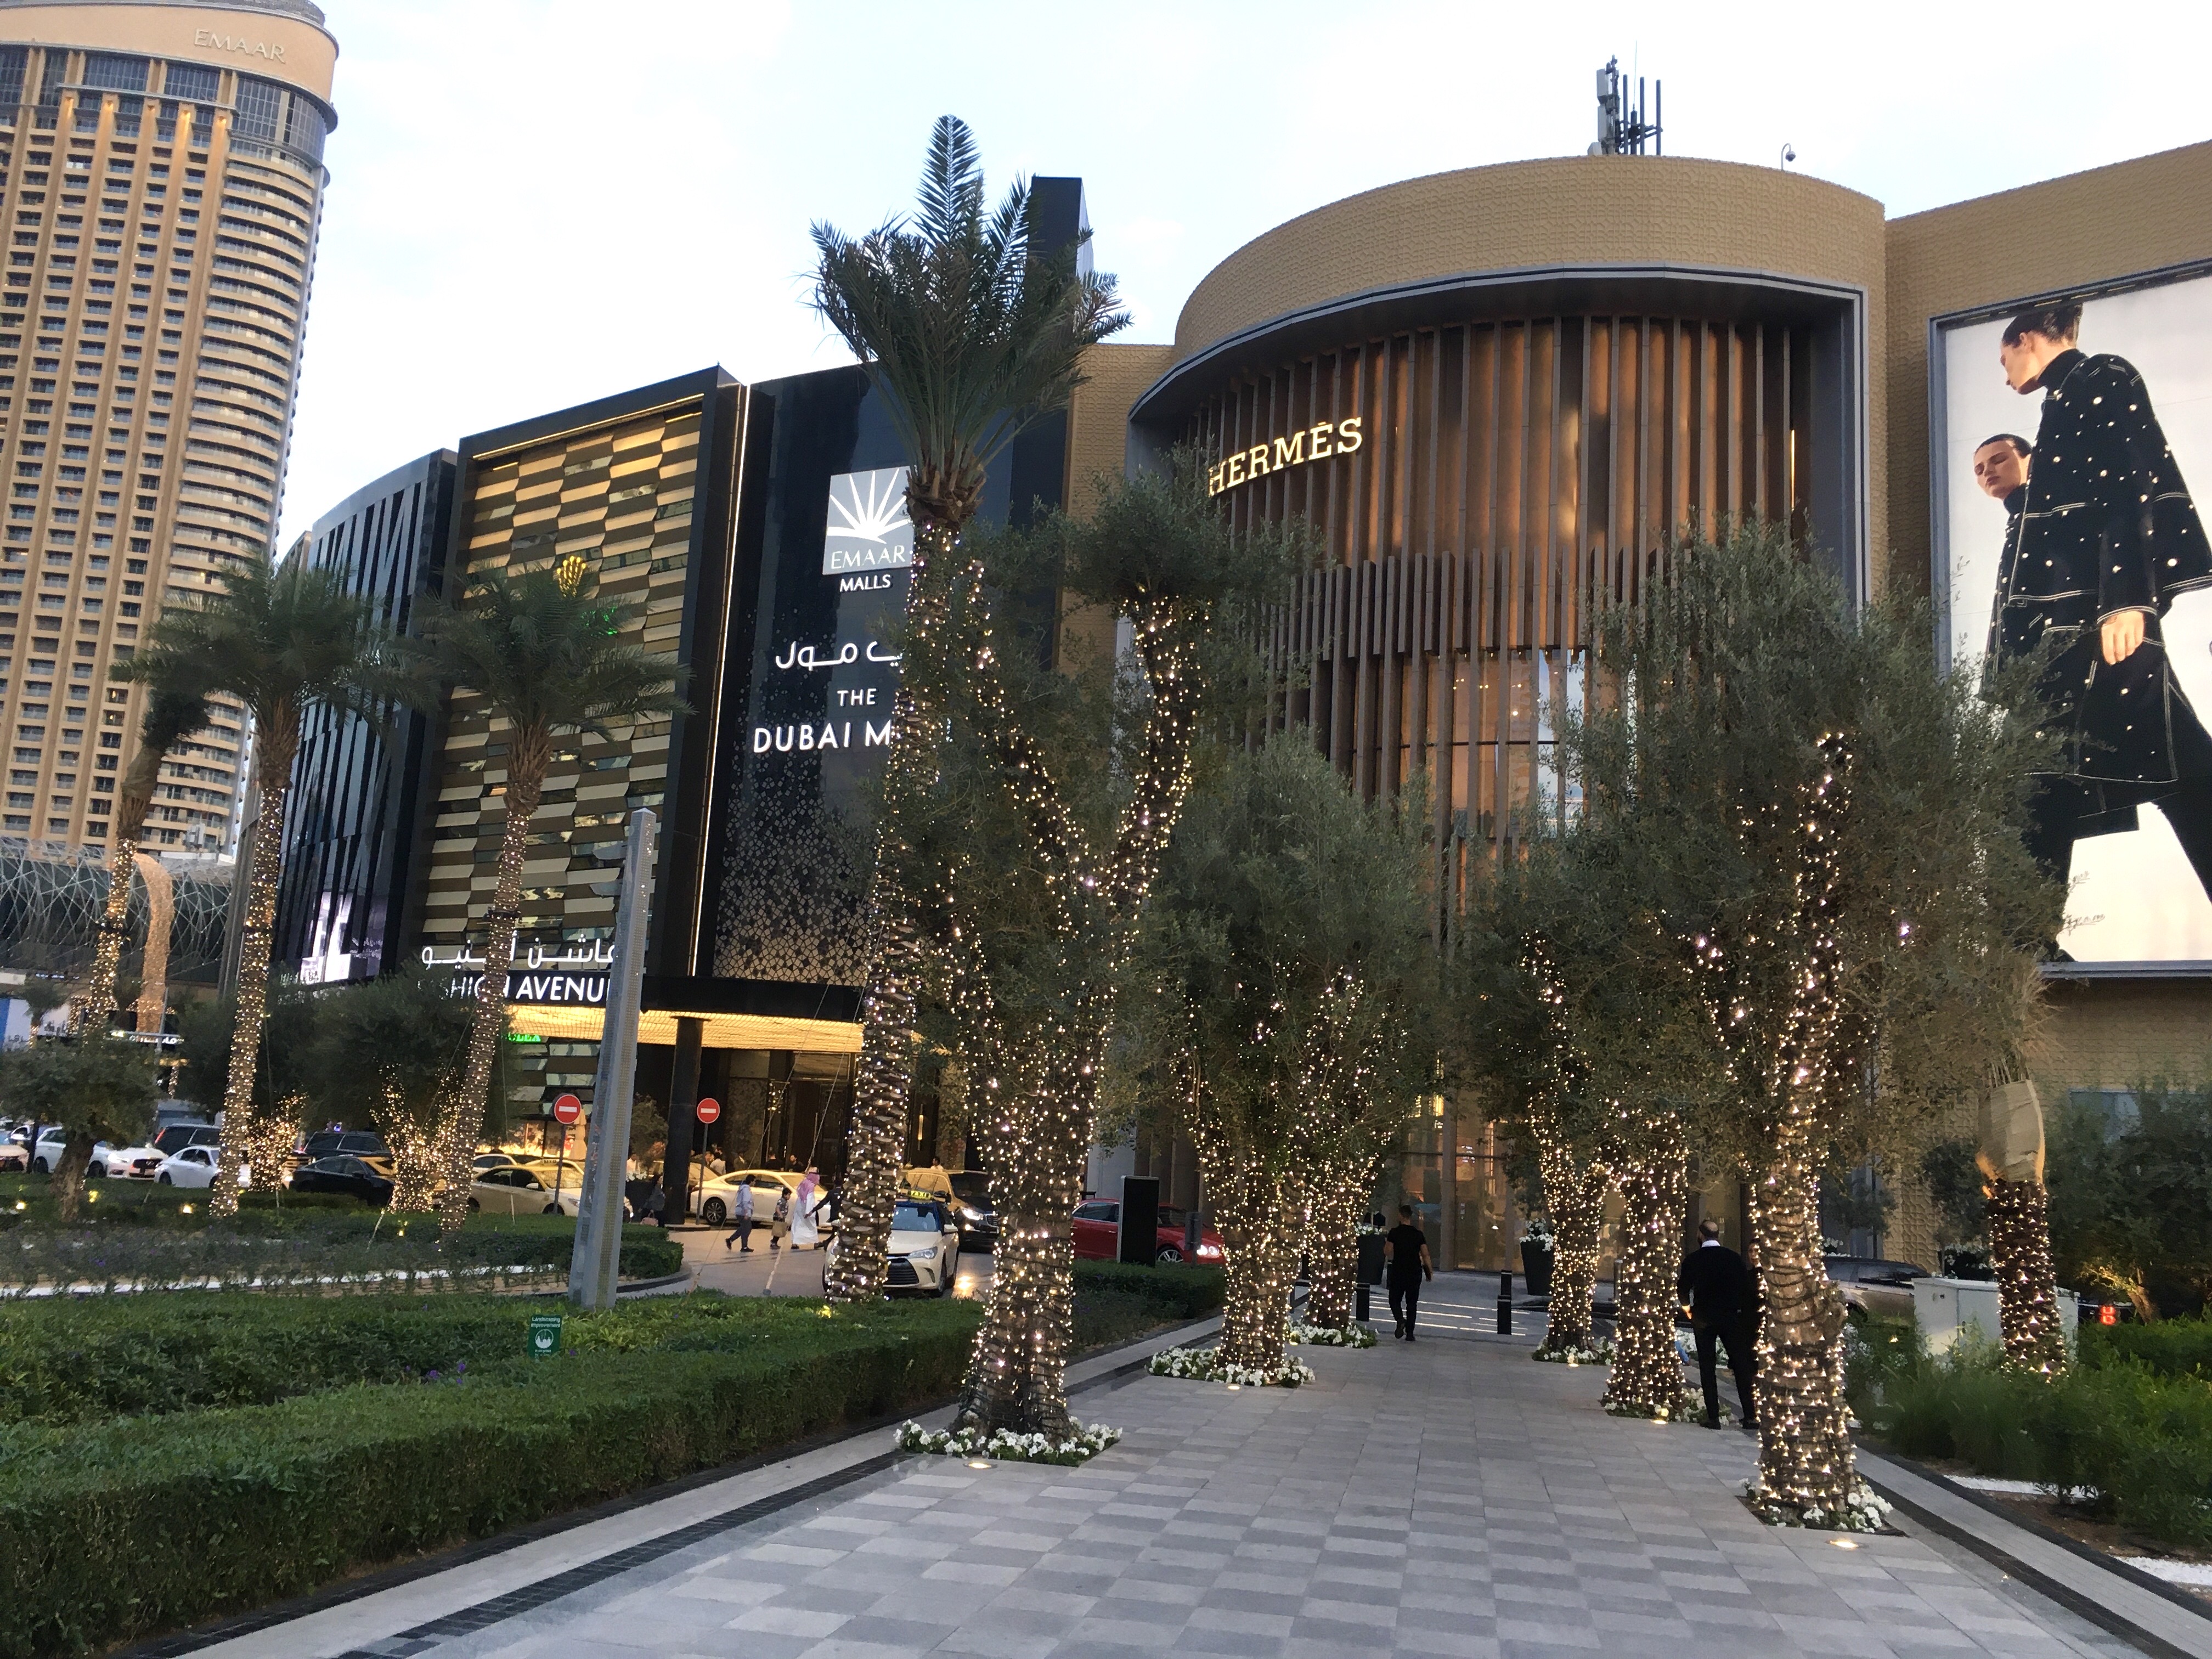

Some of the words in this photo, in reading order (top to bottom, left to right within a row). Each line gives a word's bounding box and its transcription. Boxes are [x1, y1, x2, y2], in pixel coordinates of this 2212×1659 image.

[194, 29, 285, 64] EMAAR
[831, 545, 906, 569] EMAAR
[839, 574, 891, 592] MALLS
[776, 642, 858, 670] مول
[837, 688, 877, 707] THE
[753, 721, 851, 753] DUBAI
[516, 976, 611, 1002] AVENU
